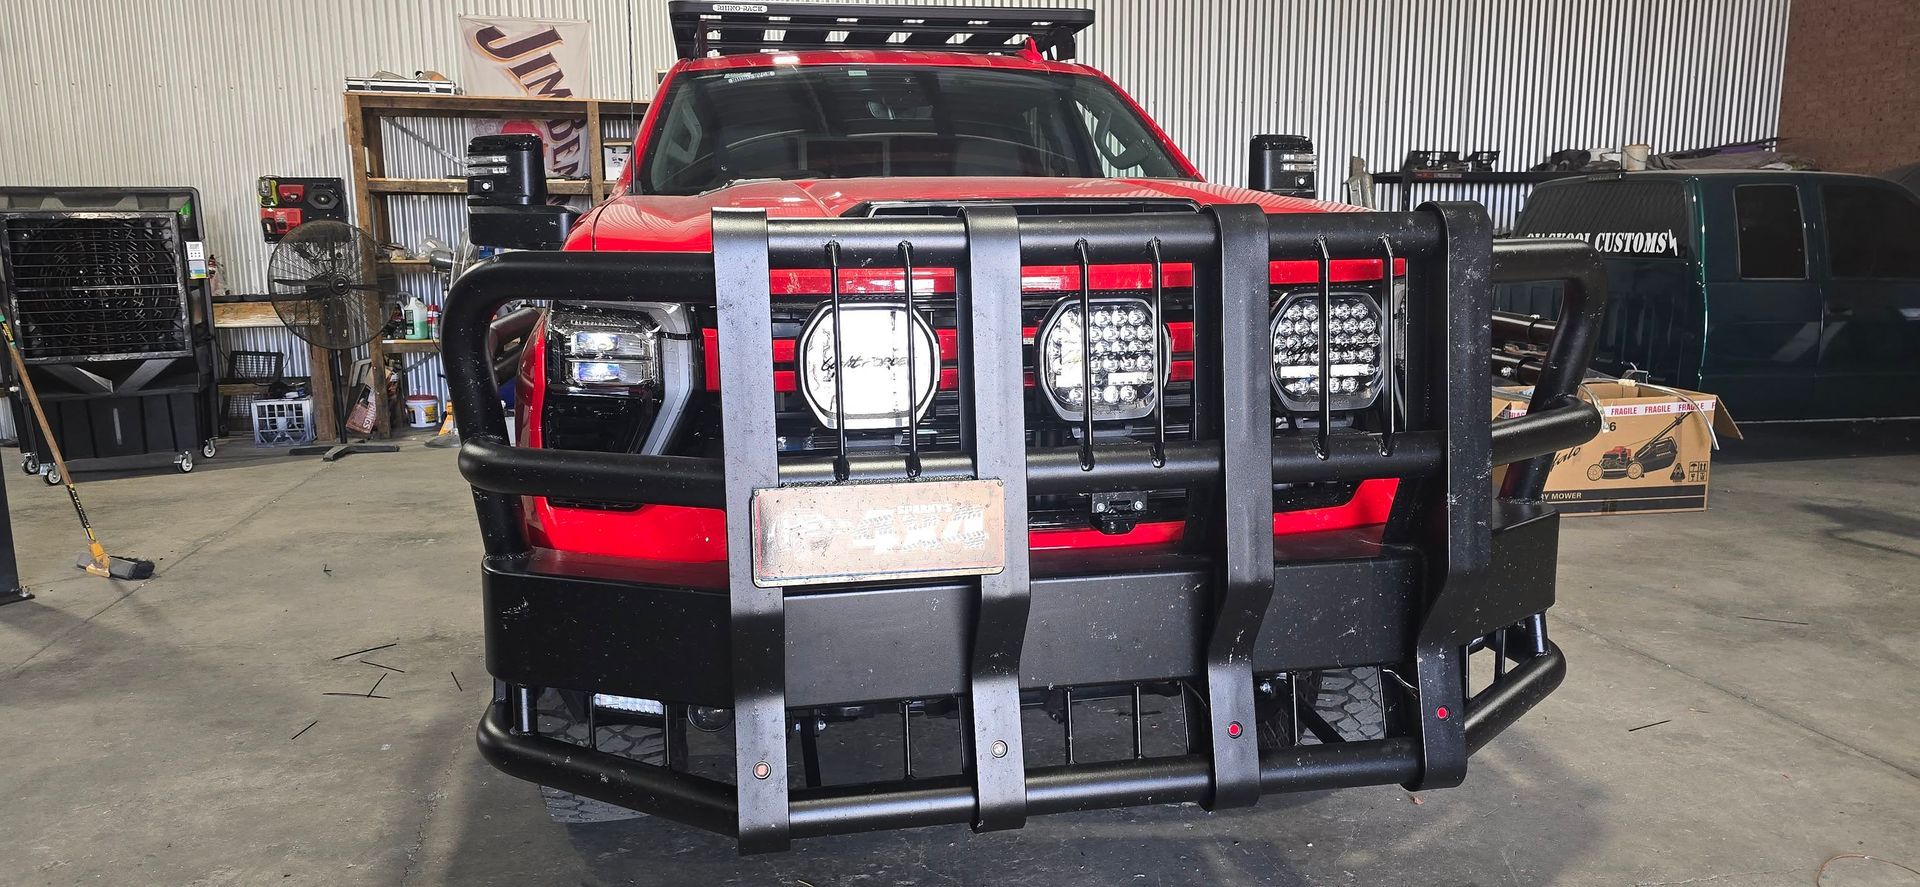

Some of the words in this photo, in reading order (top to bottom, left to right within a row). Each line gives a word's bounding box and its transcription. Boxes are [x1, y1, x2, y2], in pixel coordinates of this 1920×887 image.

[1594, 232, 1669, 254] CUSTOMS
[1611, 407, 1638, 416] FRAGILE
[1645, 405, 1671, 414] FRAGILE
[1551, 492, 1582, 500] MOWER
